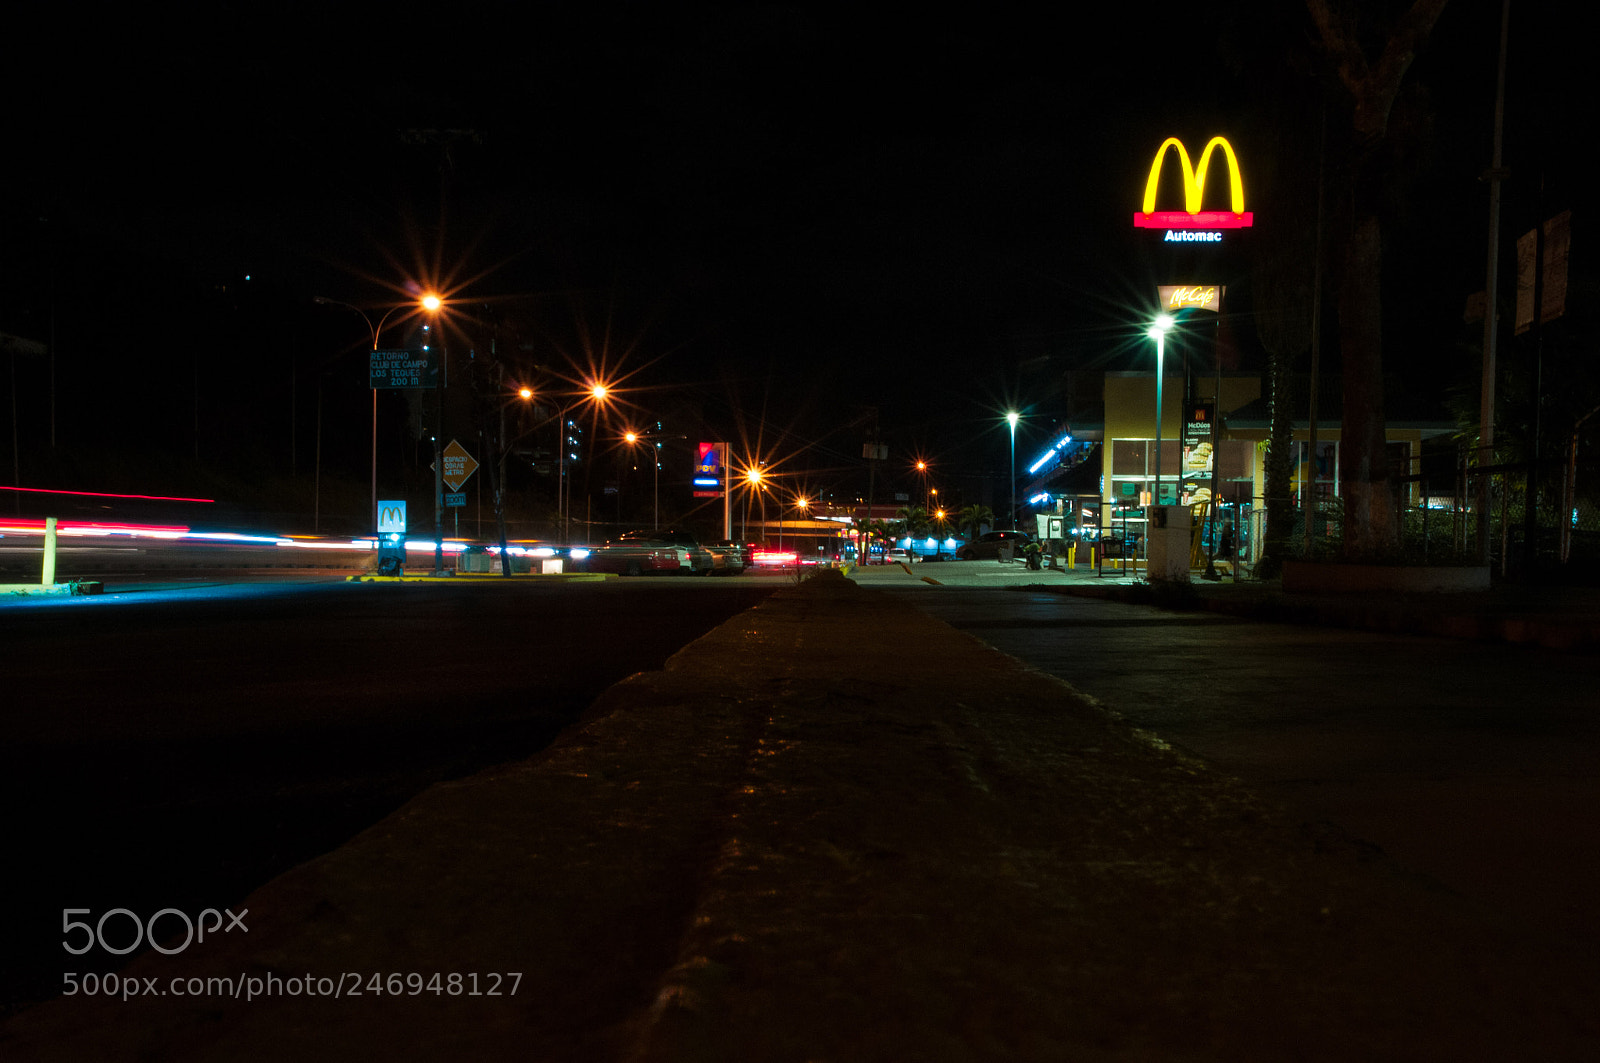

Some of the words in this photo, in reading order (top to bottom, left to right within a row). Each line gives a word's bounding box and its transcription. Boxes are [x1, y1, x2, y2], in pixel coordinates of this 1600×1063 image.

[1164, 229, 1223, 242] Automac
[370, 352, 410, 361] RETORNO
[371, 360, 390, 369] CLUB
[390, 360, 401, 369] DE
[402, 360, 428, 369] CAMPO
[370, 369, 387, 378] LOS
[391, 377, 408, 386] 200
[695, 464, 717, 473] PDV
